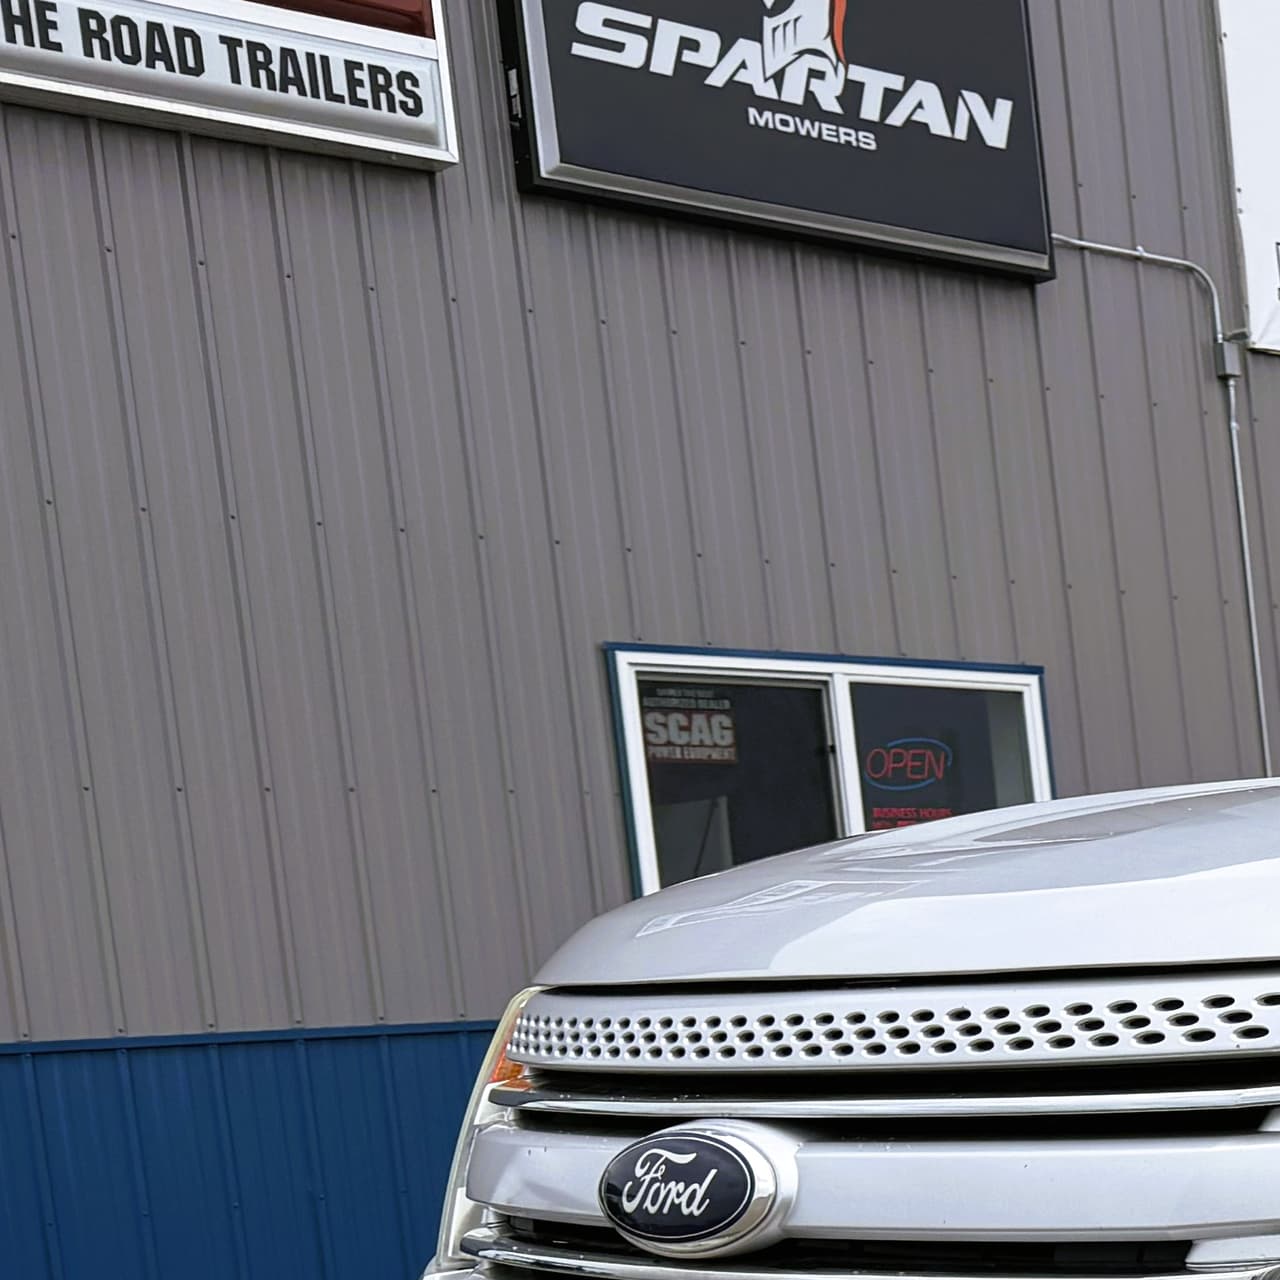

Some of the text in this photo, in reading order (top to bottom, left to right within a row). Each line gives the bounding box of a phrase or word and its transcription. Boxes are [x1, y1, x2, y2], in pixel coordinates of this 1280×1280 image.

[1, 0, 425, 118] HE ROAD TRAILERS
[570, 1, 1013, 150] SPARTAN
[747, 106, 877, 151] MOWERS
[645, 711, 734, 747] SCAG
[866, 747, 945, 780] OPEN
[621, 1148, 718, 1217] Ford
